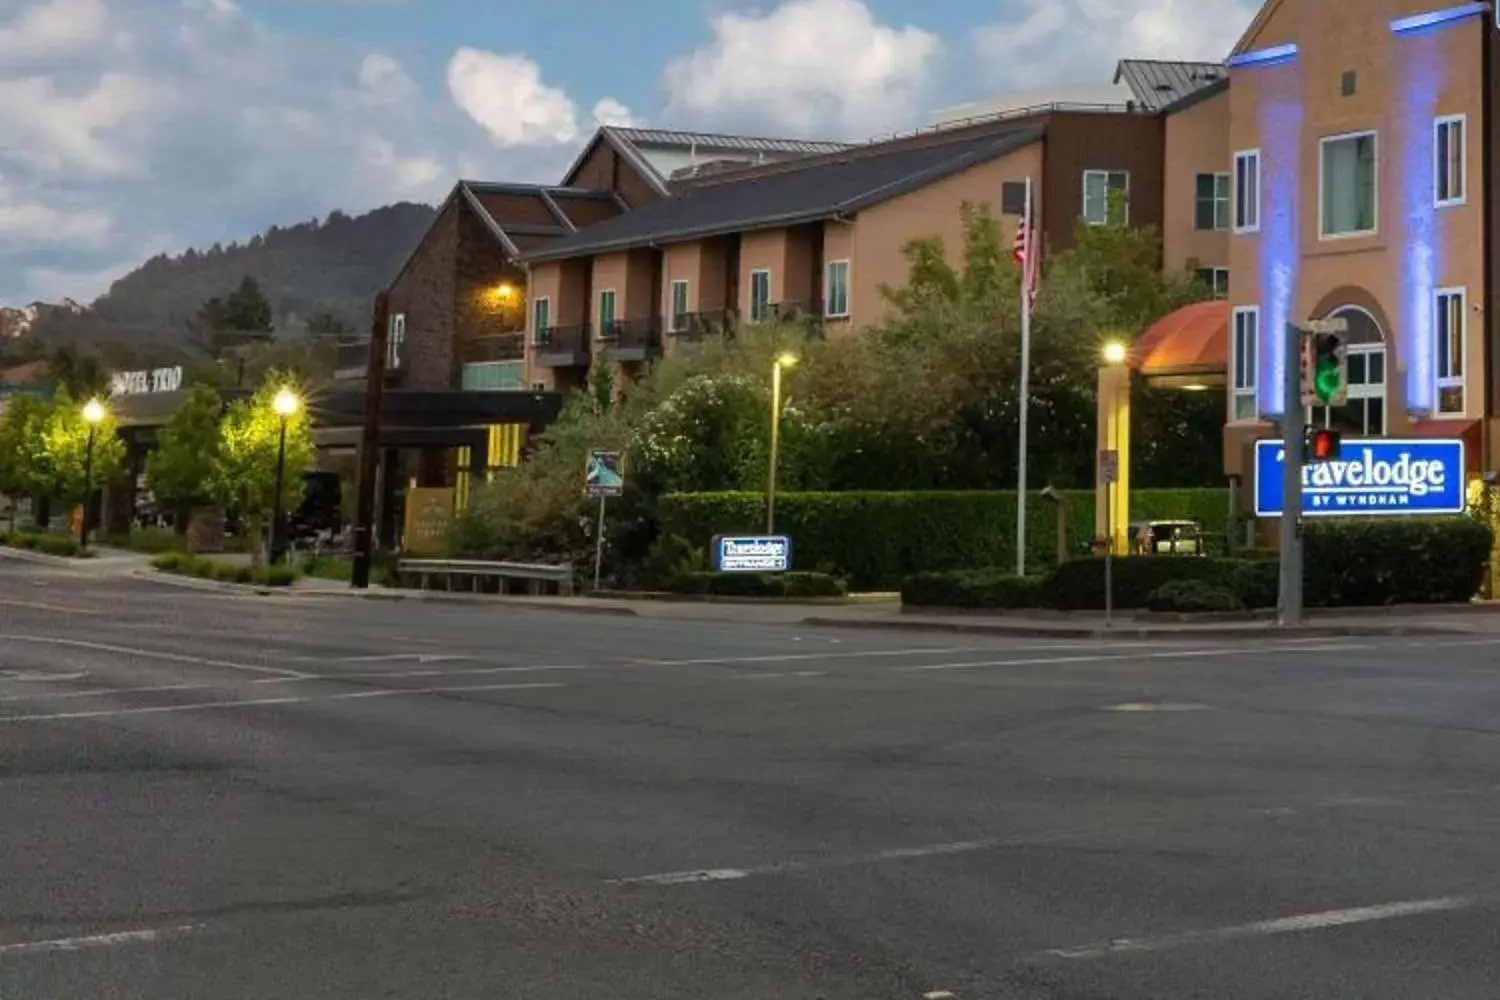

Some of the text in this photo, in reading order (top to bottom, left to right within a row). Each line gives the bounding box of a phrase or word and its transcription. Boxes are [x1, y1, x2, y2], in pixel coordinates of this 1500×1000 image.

[1276, 449, 1445, 495] ravelodge
[1312, 494, 1409, 505] BY WYNDHAM
